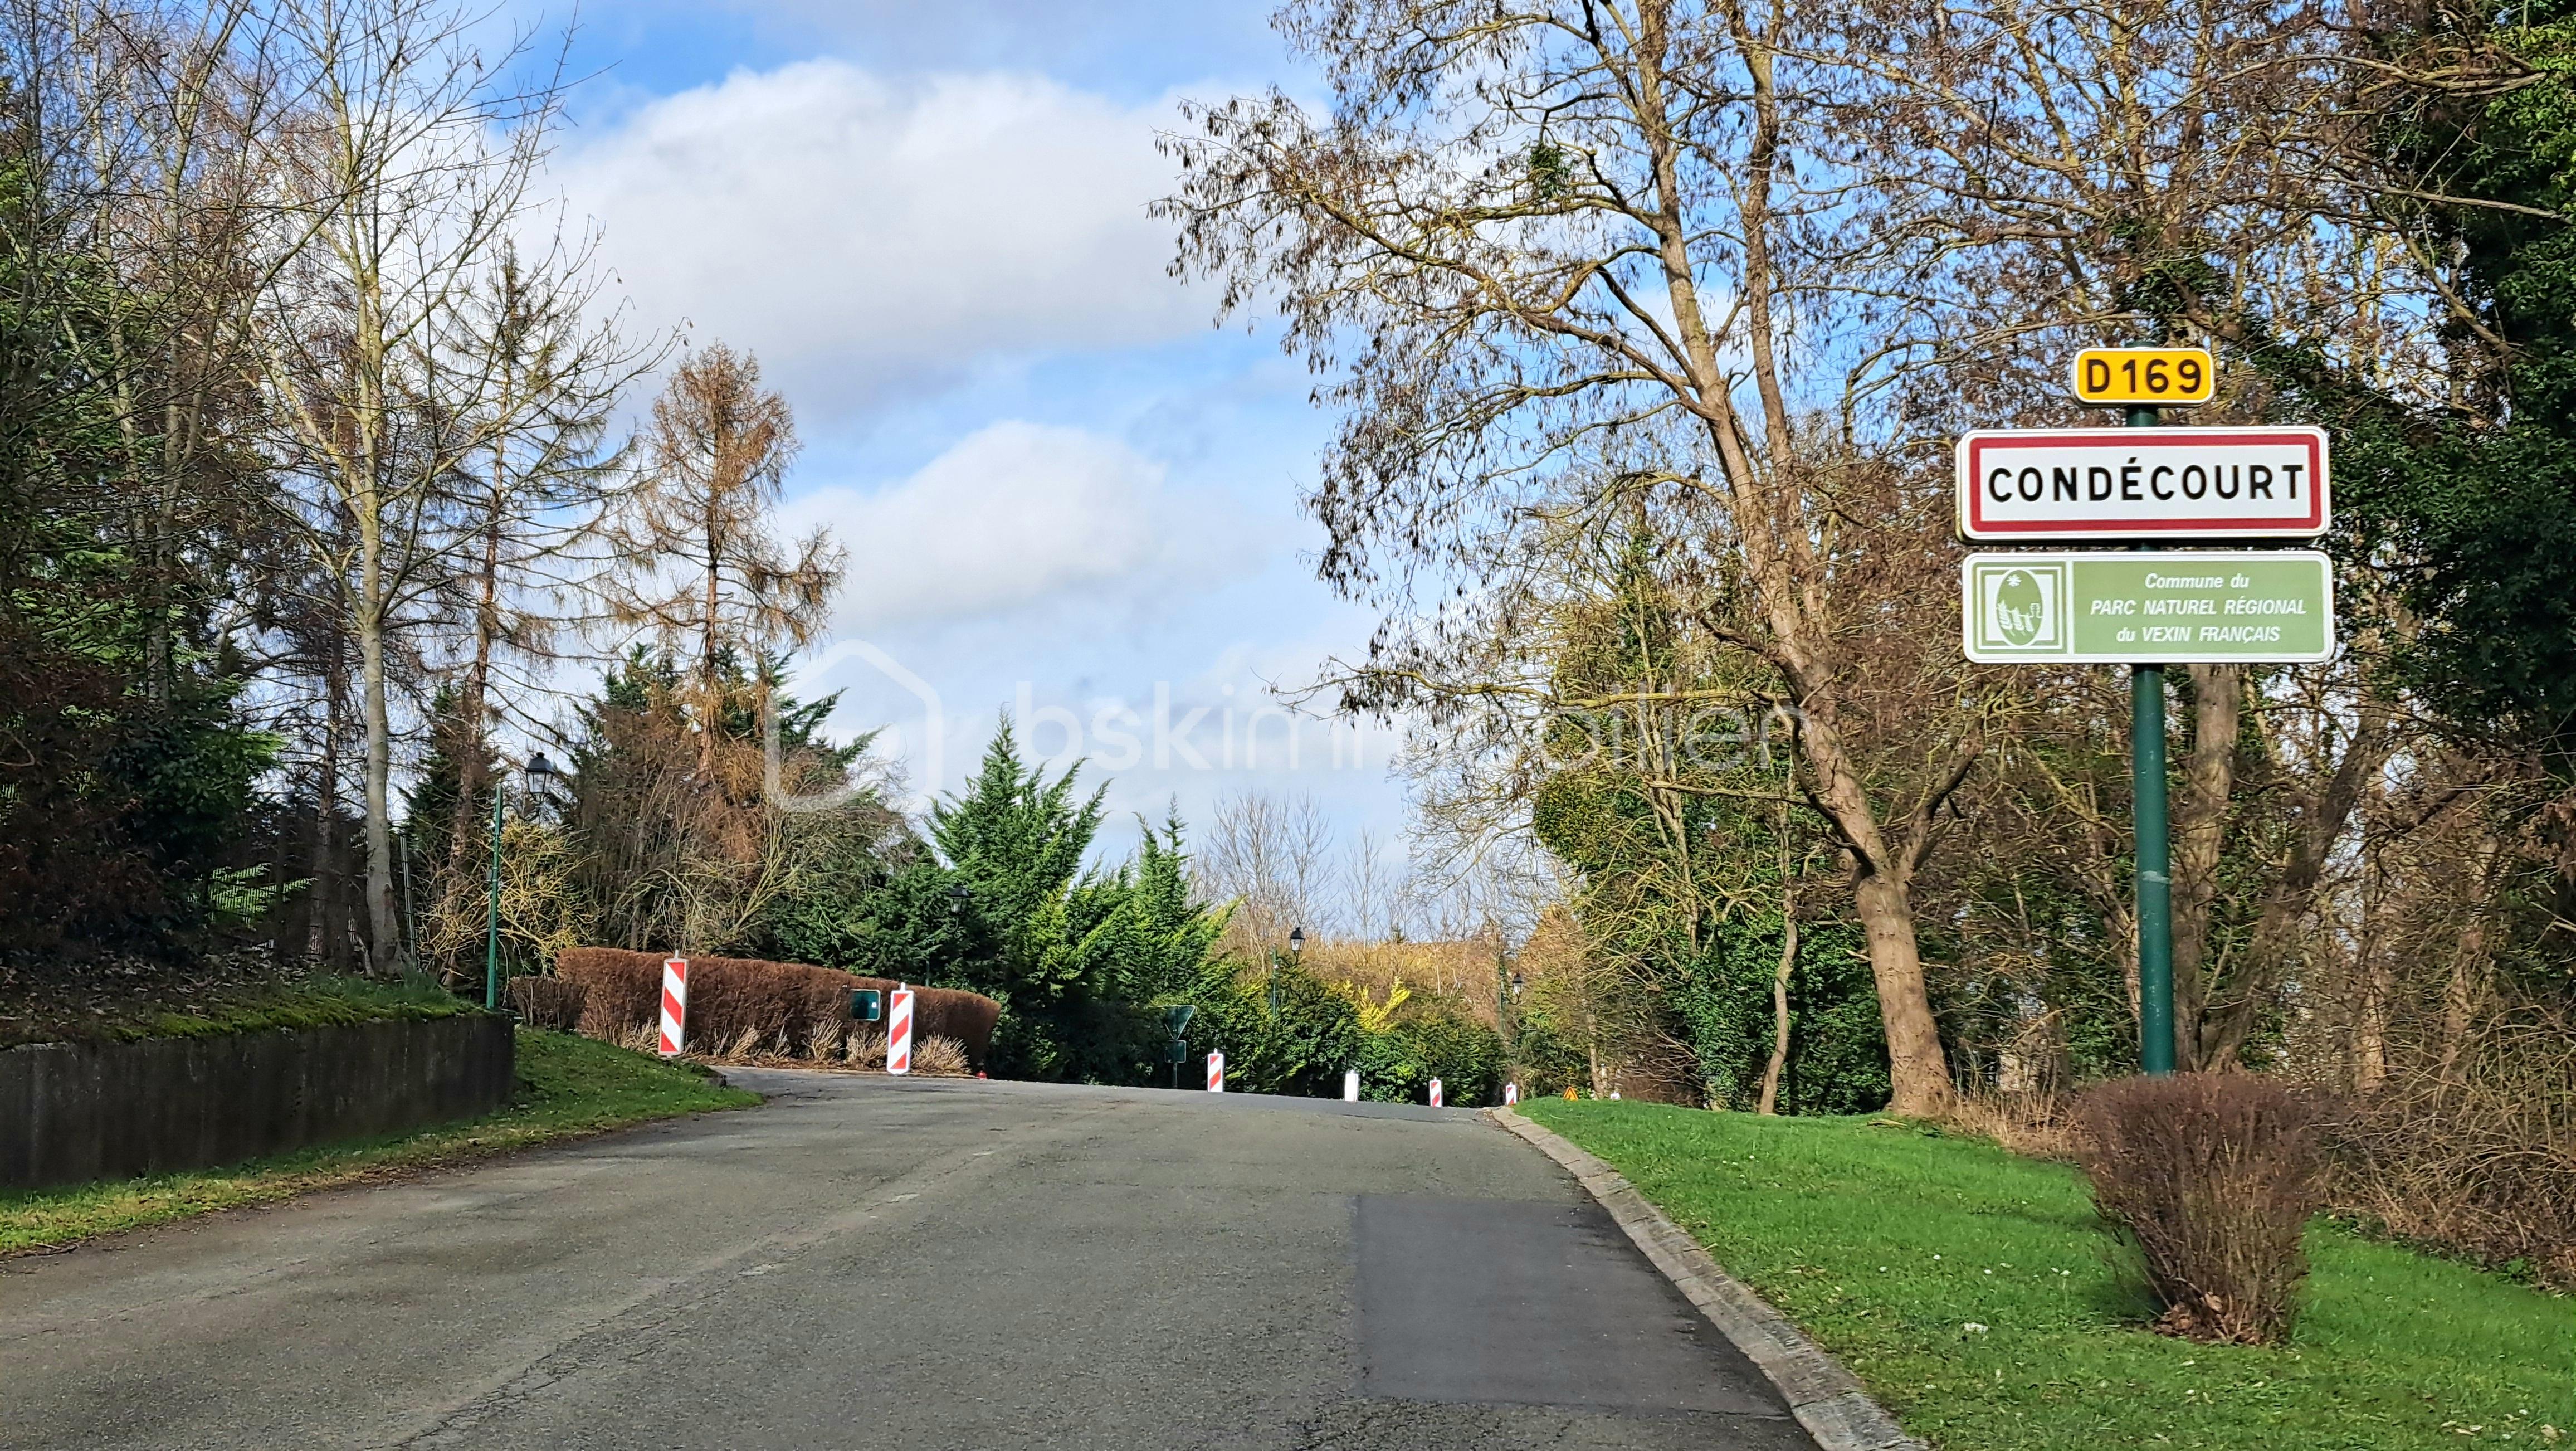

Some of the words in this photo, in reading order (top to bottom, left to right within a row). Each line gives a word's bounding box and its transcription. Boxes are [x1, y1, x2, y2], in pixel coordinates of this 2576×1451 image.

[1988, 457, 2304, 502] CONDÉCOURT
[2145, 573, 2223, 589] Commune
[2230, 573, 2250, 589] du
[2090, 600, 2137, 616] PARC
[2143, 600, 2217, 615] NATUREL
[2223, 595, 2307, 615] RÉGIONAL
[2116, 627, 2135, 642] du
[2142, 627, 2191, 642] VEXIN
[2198, 626, 2281, 644] FRANÇAIS
